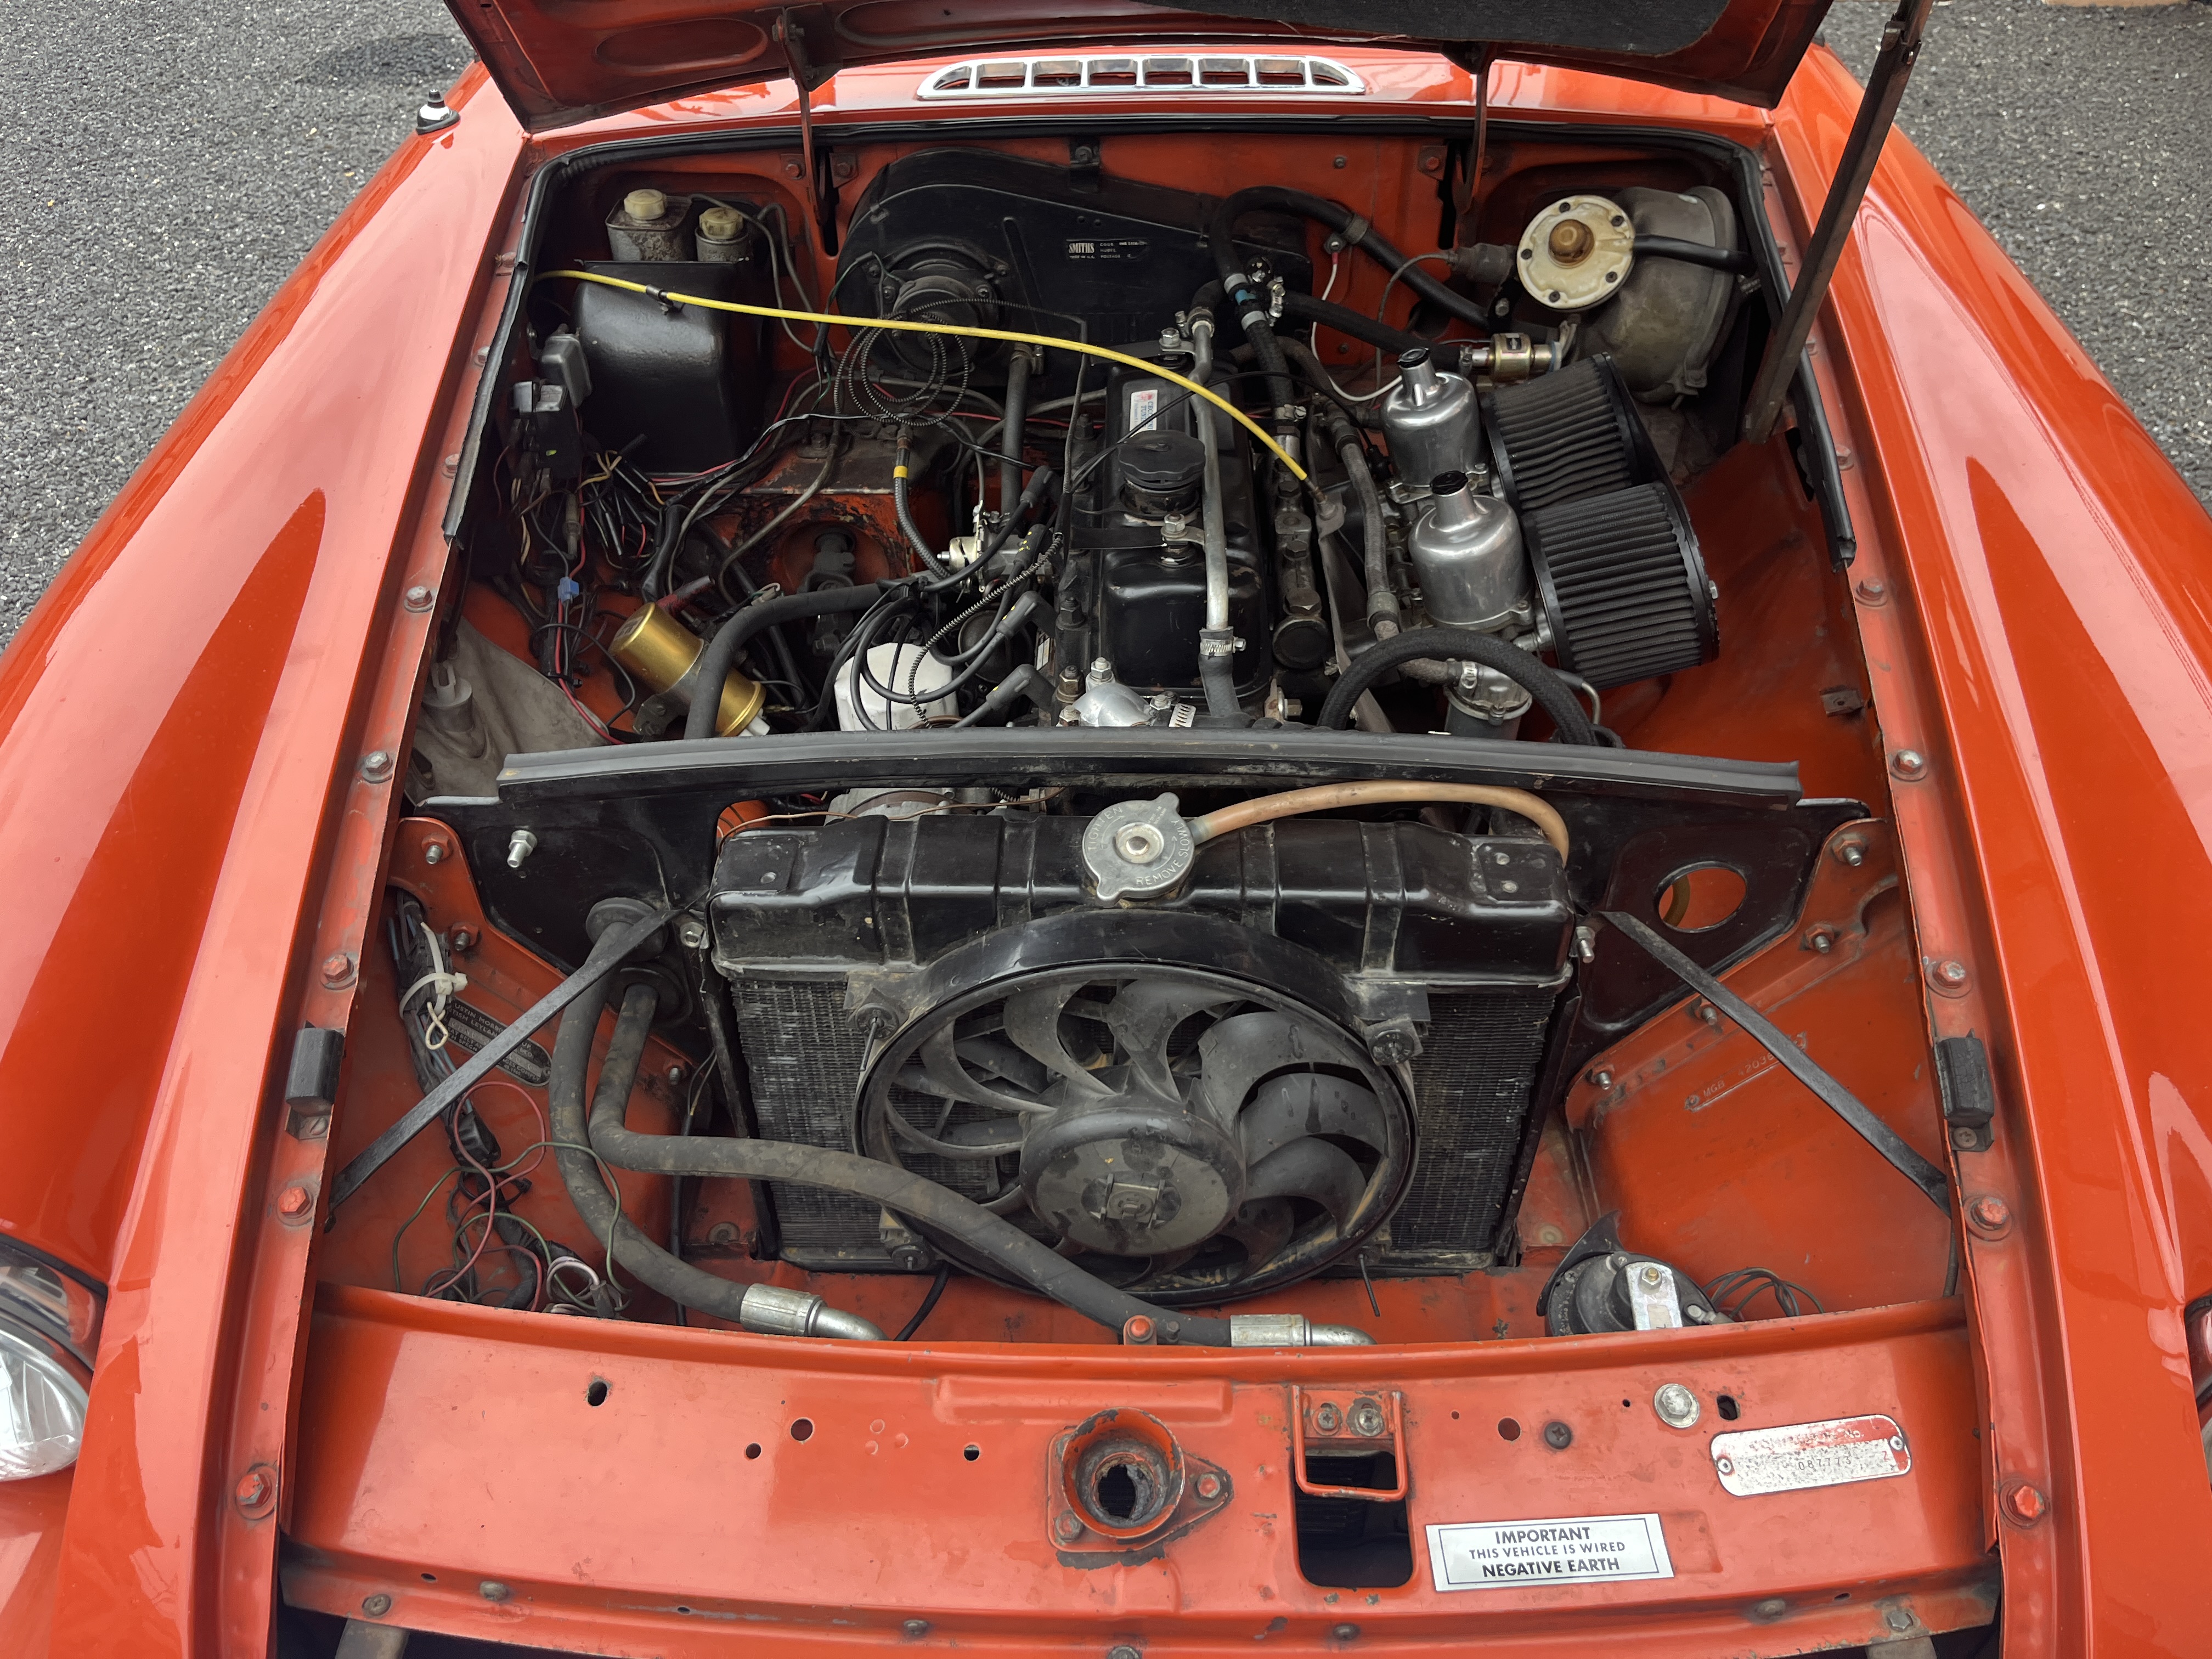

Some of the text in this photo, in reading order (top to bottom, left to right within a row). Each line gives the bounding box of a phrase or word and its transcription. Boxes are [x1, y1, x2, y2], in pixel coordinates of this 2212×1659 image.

[1068, 242, 1095, 253] SMITHS
[1088, 806, 1122, 851] TIGHTEN
[1136, 859, 1183, 885] REMOVE
[1171, 820, 1190, 858] SLOWLY
[454, 1003, 476, 1018] USTIN
[471, 1019, 498, 1037] LEYLAN
[1702, 1080, 1725, 1098] MGB
[1495, 1526, 1590, 1544] IMPORTANT
[1469, 1542, 1626, 1560] THIS VEHICLE IS WIRED
[1482, 1558, 1620, 1577] NEGATIVE EARTH
